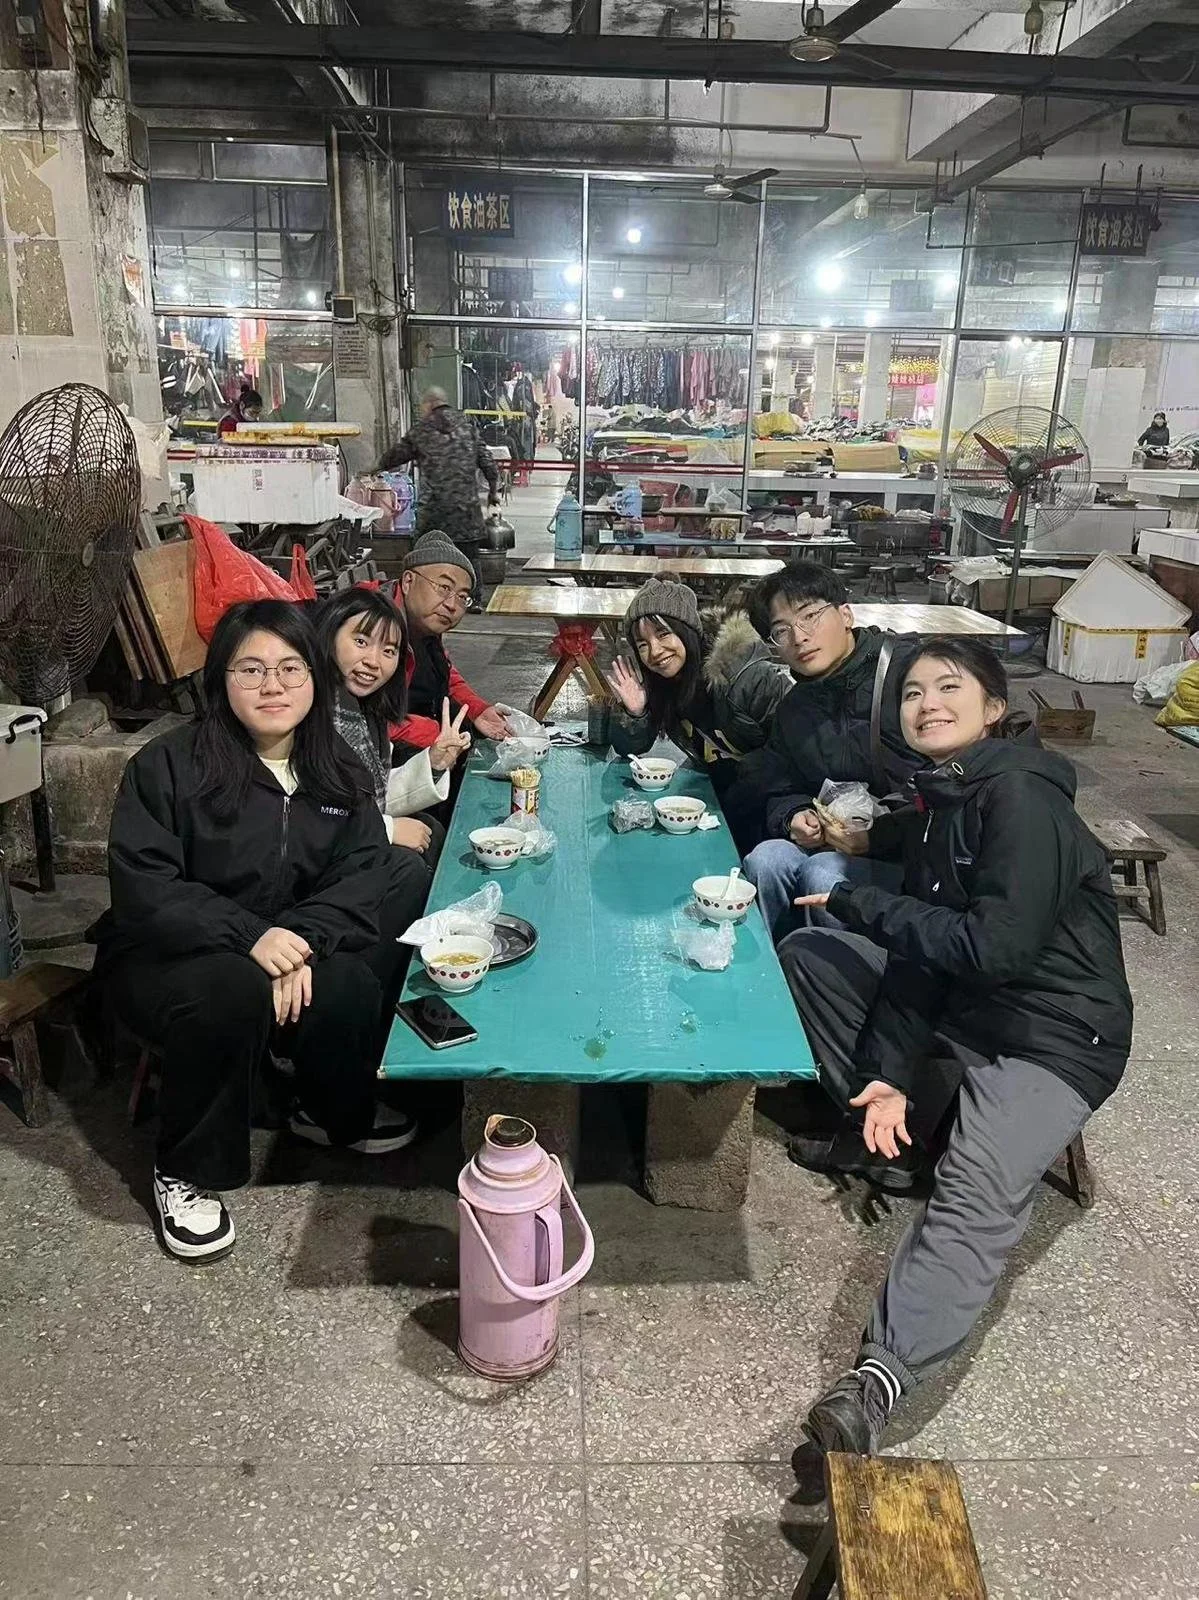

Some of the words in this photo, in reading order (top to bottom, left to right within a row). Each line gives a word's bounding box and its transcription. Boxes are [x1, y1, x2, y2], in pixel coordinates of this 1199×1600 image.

[448, 191, 511, 230] 饮食油茶区
